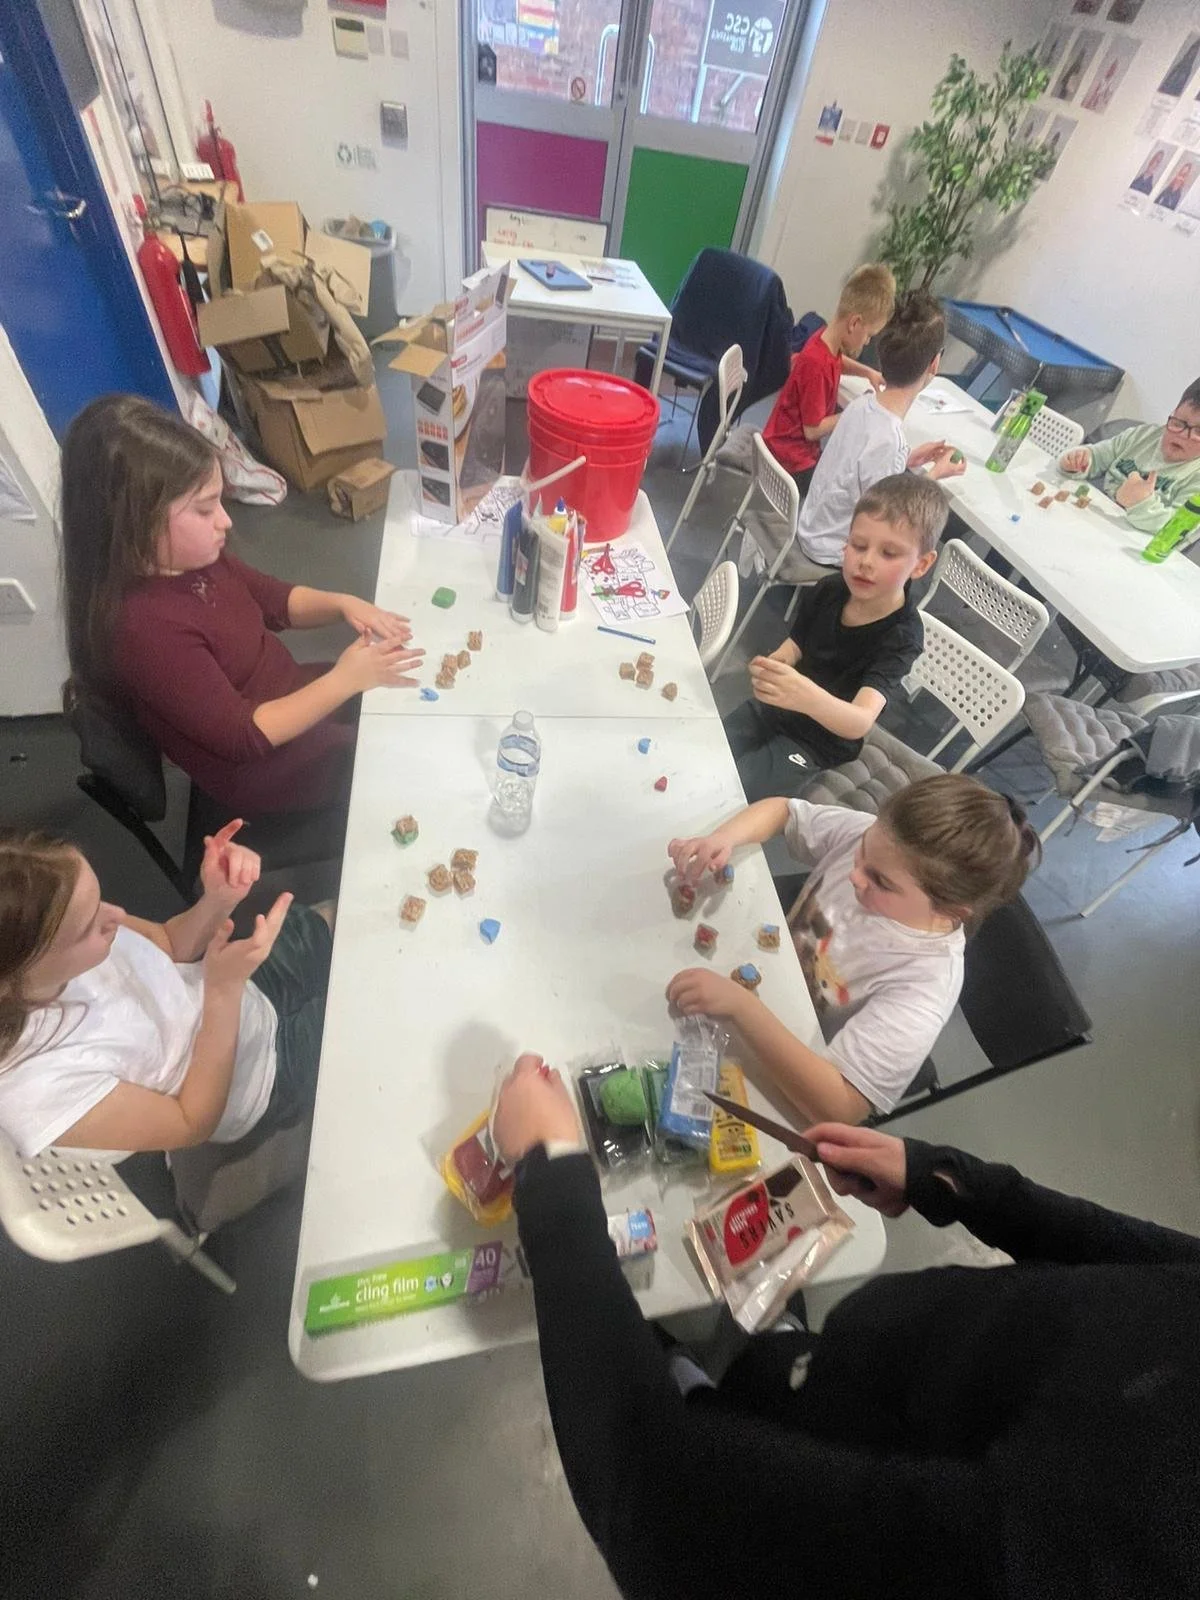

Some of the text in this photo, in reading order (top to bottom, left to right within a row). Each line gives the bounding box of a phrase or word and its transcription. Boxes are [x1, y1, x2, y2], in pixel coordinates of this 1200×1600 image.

[475, 1247, 497, 1268] 40
[356, 1283, 390, 1305] cling
[393, 1276, 419, 1294] film
